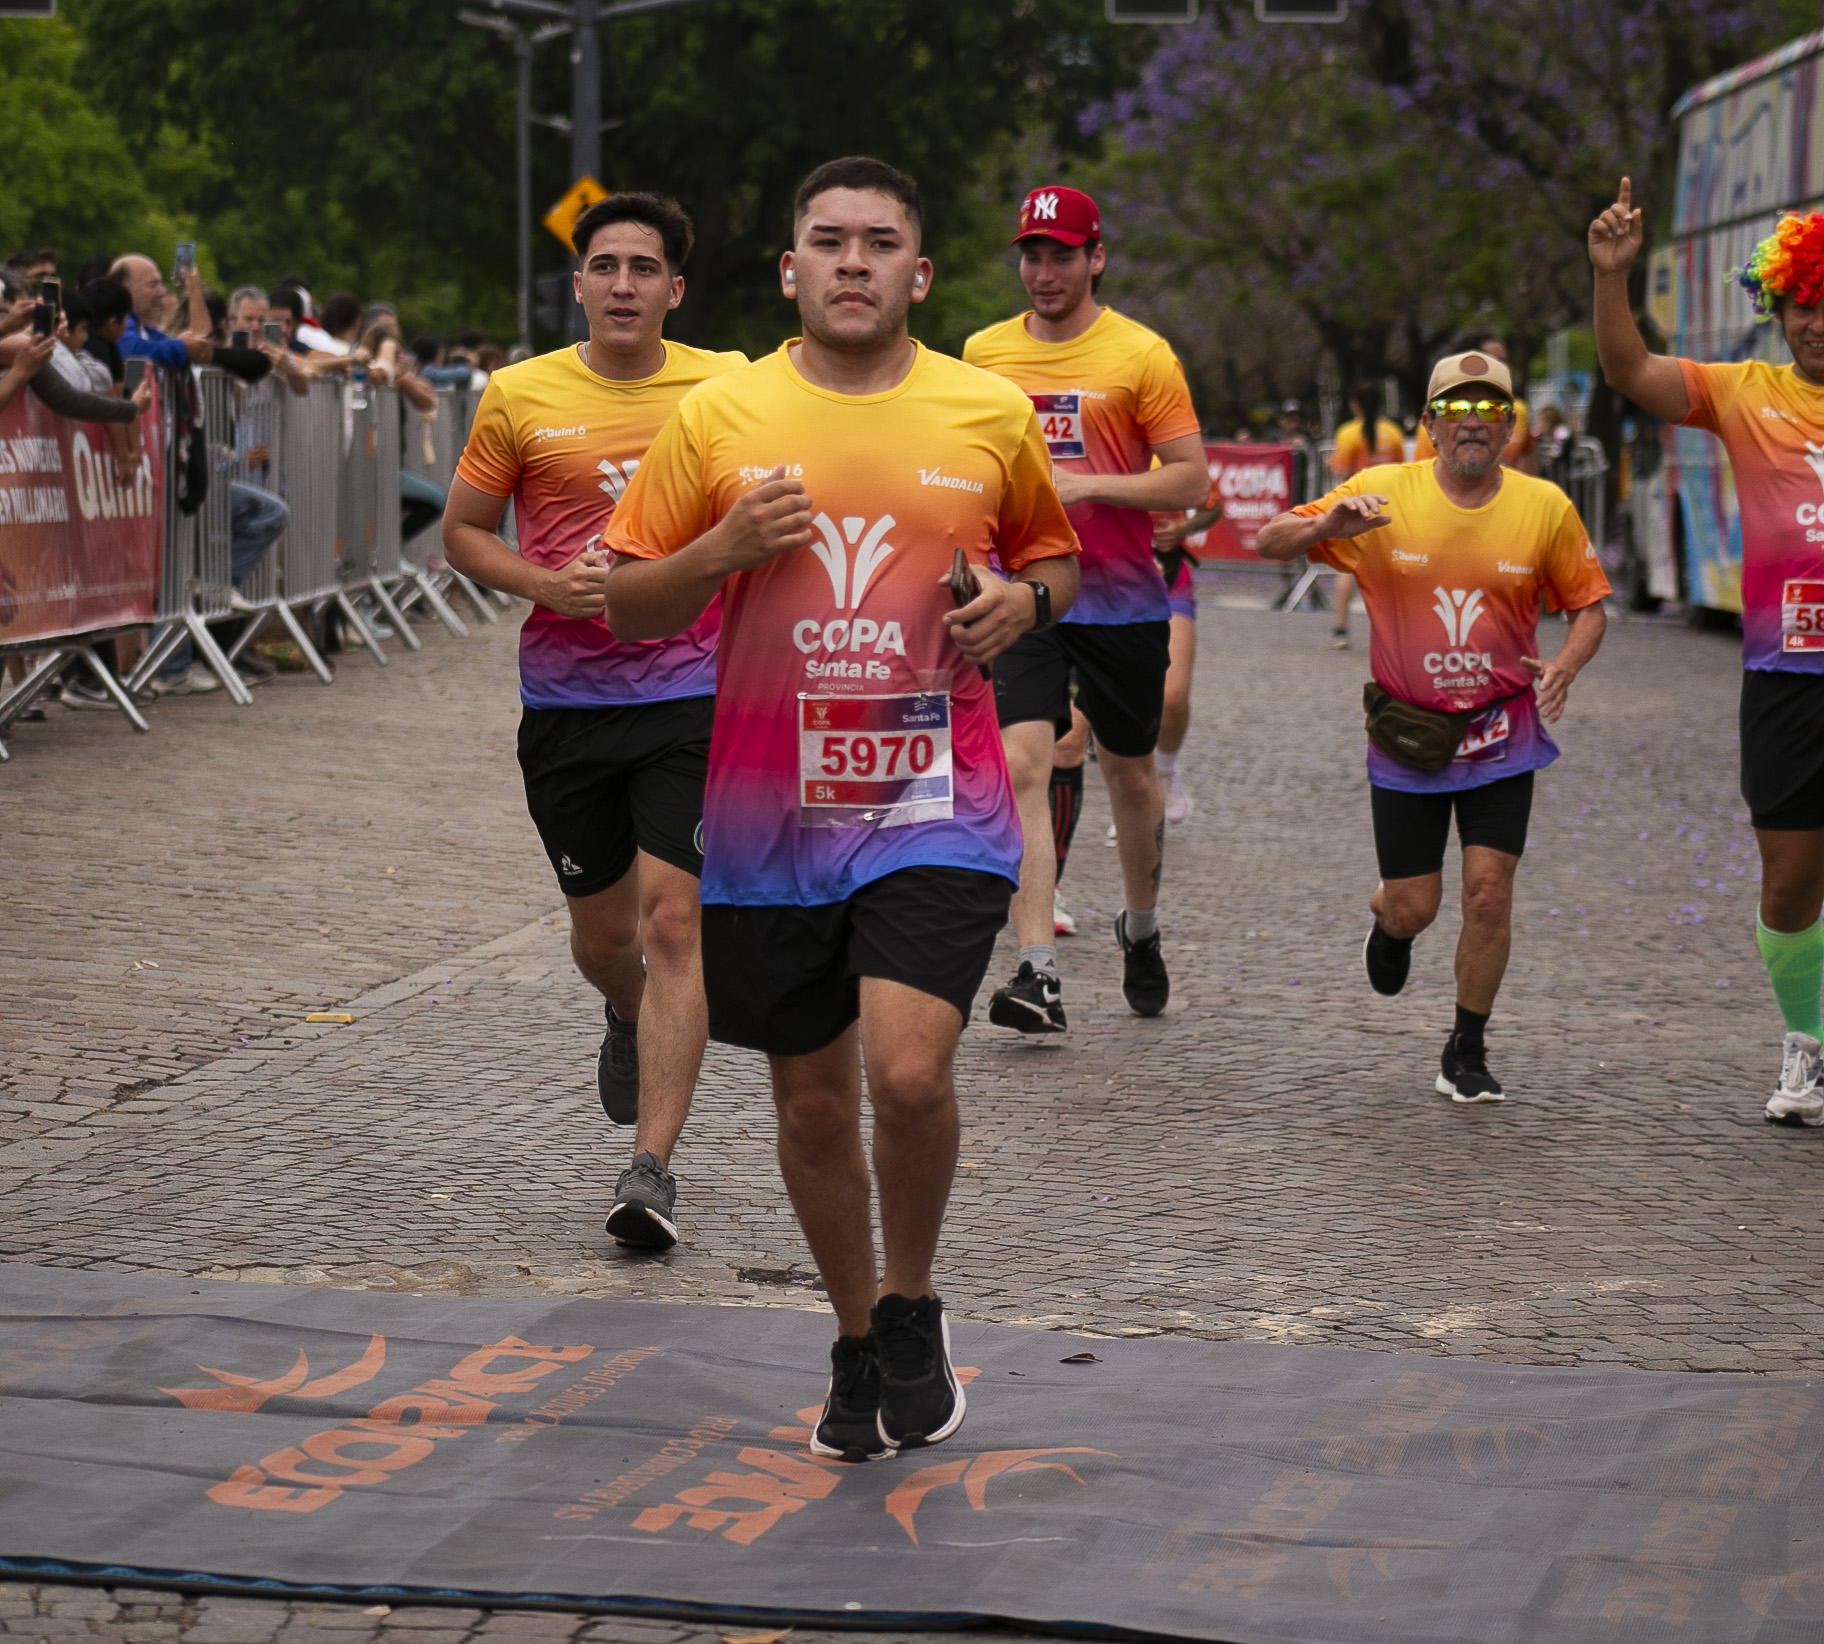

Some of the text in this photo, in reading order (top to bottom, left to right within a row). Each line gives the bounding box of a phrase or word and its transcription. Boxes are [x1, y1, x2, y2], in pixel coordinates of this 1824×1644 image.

[578, 426, 586, 436] 6
[1044, 416, 1074, 439] 42
[793, 463, 803, 477] 6
[917, 466, 984, 494] VANDALIA
[793, 618, 907, 657] COPA
[805, 659, 891, 681] Santa Fe
[1423, 652, 1493, 674] COPA
[818, 682, 865, 692] PROVINCIA
[1433, 676, 1475, 689] Santa
[902, 713, 941, 723] Santa Fe
[821, 734, 934, 777] 5970
[815, 786, 836, 800] 5k
[204, 1335, 595, 1523] ECORACE
